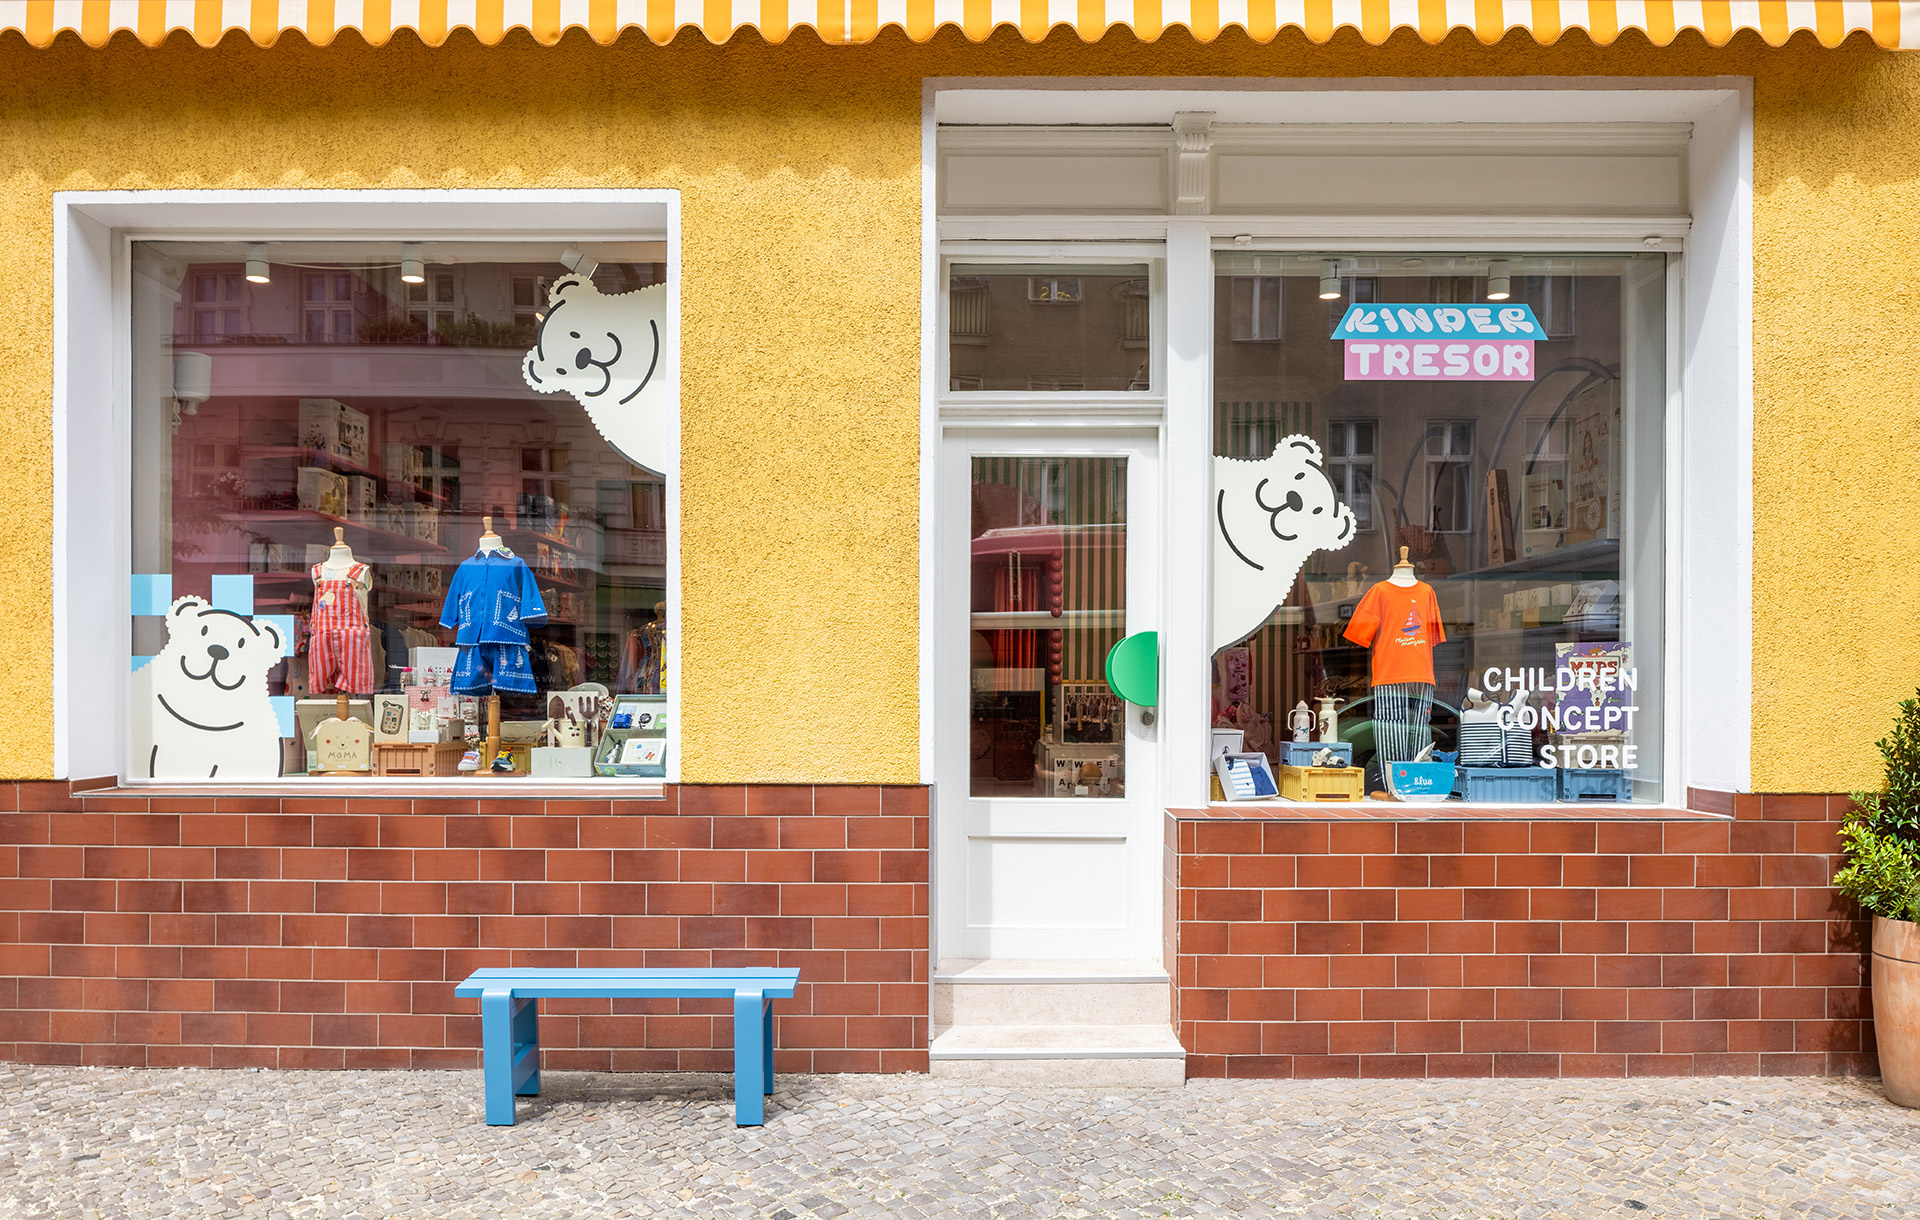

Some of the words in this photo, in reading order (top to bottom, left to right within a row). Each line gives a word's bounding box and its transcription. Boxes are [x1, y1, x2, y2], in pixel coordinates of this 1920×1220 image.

[1344, 307, 1535, 333] KINDER
[1349, 344, 1530, 377] TRESOR
[1483, 667, 1638, 692] CHILDREN
[1496, 705, 1639, 731] CONCEPT
[1539, 745, 1639, 769] STORE
[1414, 775, 1433, 785] Blue
